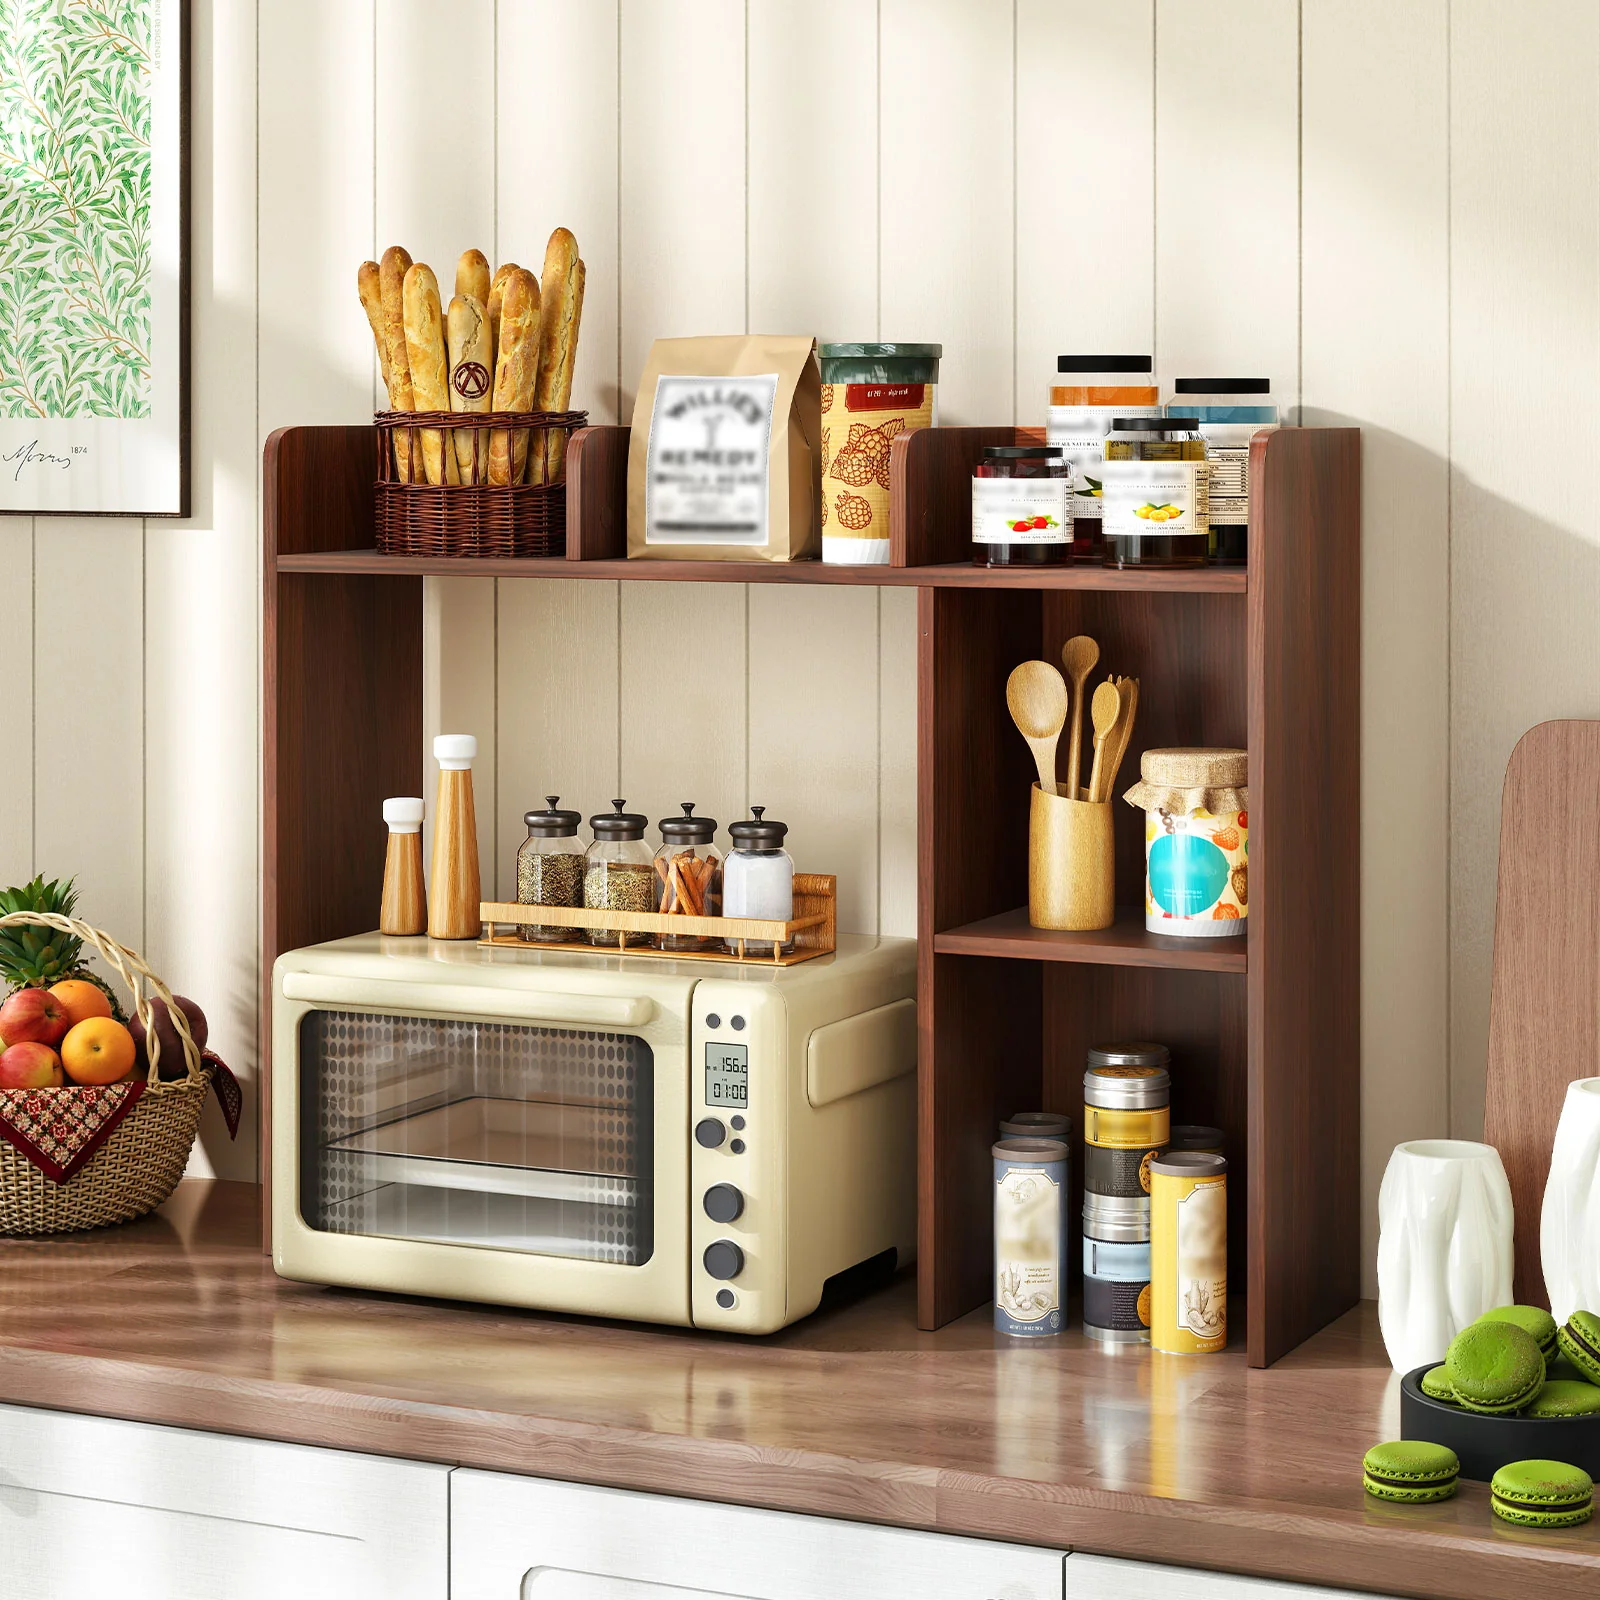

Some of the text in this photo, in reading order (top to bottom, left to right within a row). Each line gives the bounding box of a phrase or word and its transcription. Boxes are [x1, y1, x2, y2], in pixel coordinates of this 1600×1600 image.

[154, 60, 161, 70] BY
[71, 446, 88, 454] 1874
[713, 1083, 747, 1100] 01:00
